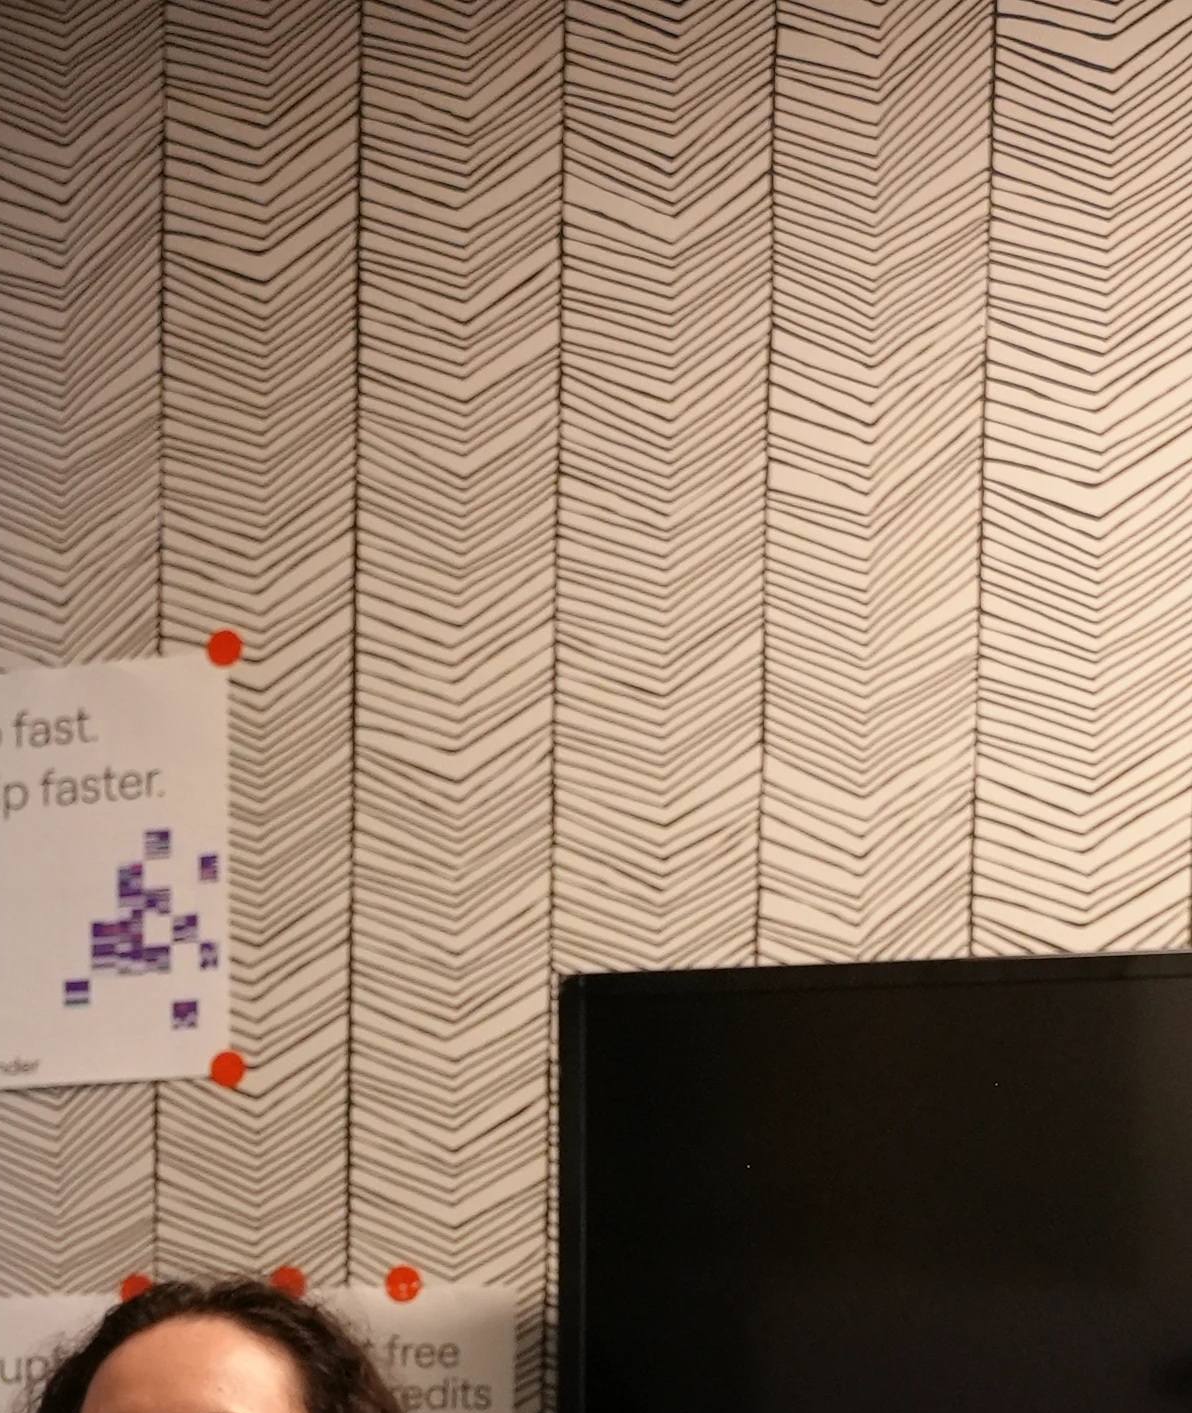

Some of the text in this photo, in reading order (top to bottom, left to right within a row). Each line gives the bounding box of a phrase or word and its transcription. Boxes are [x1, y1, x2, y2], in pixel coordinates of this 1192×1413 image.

[13, 707, 99, 748] fast.
[41, 766, 166, 807] faster.
[386, 1334, 460, 1368] free
[390, 1377, 492, 1410] redits
